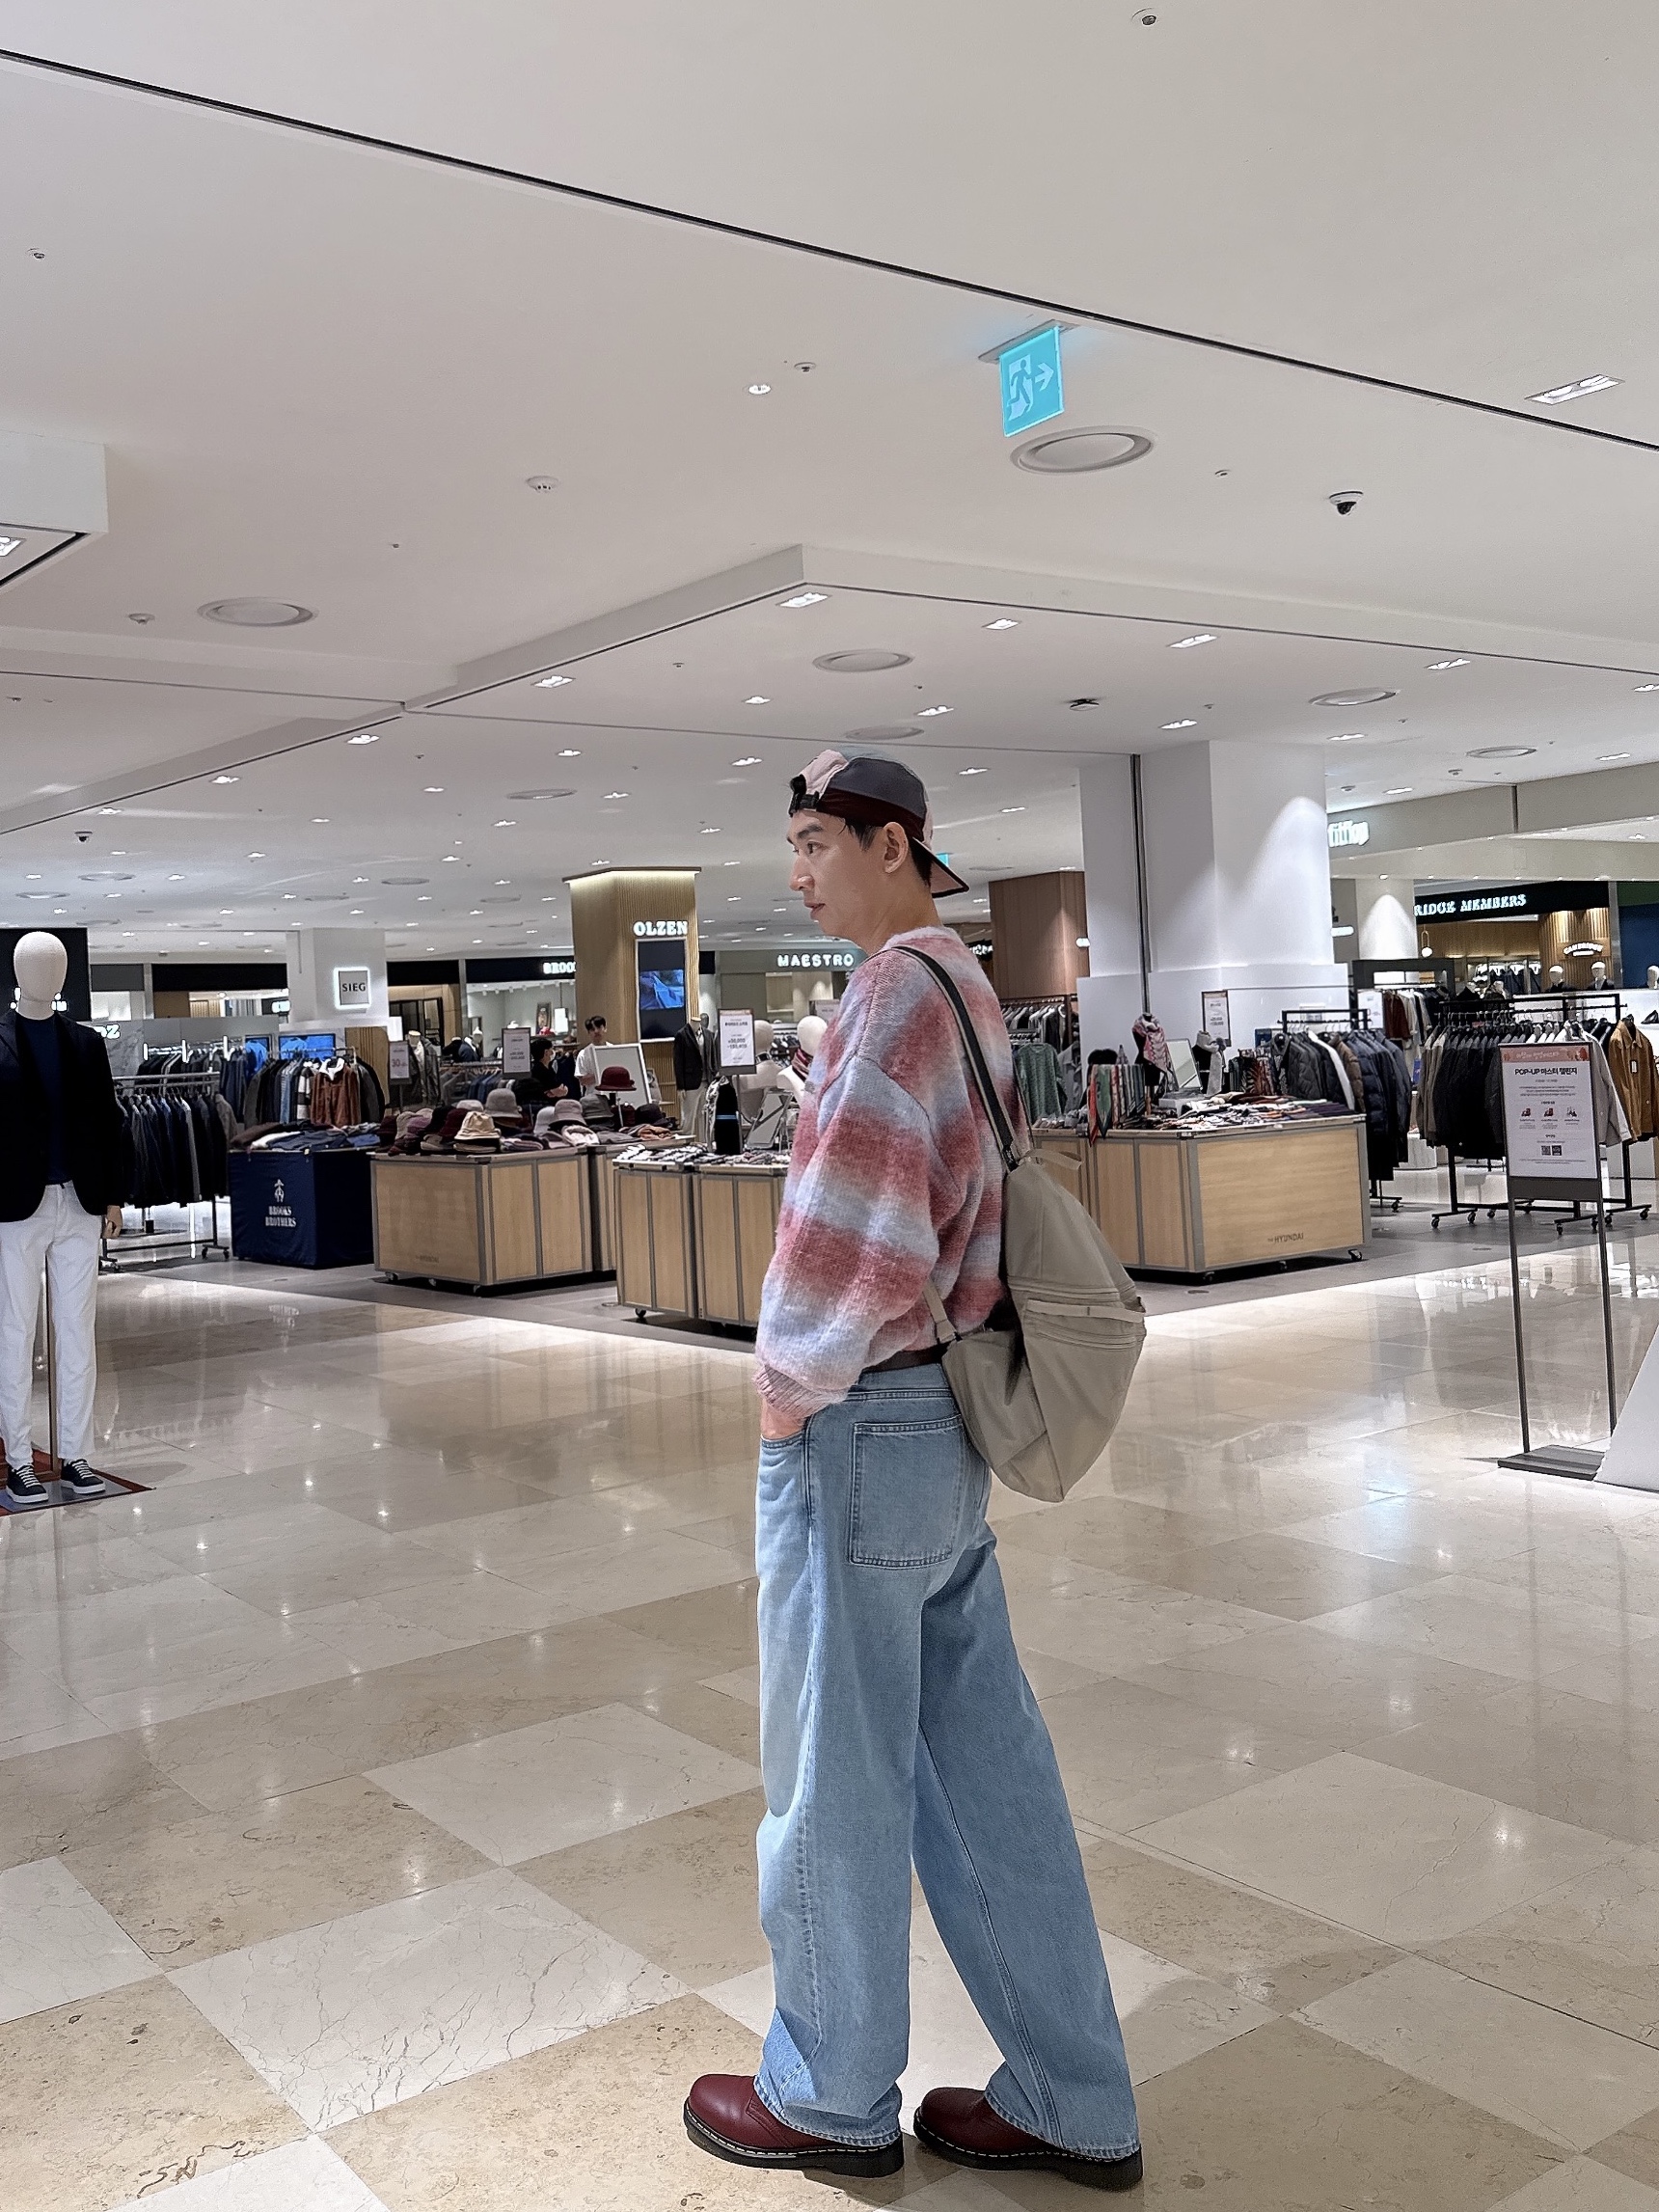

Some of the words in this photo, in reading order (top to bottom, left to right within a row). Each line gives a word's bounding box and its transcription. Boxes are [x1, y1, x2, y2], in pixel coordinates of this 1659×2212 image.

[1460, 893, 1526, 912] MEMBERS
[633, 920, 688, 936] OLZEN
[543, 962, 576, 974] BROO
[777, 953, 854, 968] MAESTRO
[342, 982, 367, 992] SIEG
